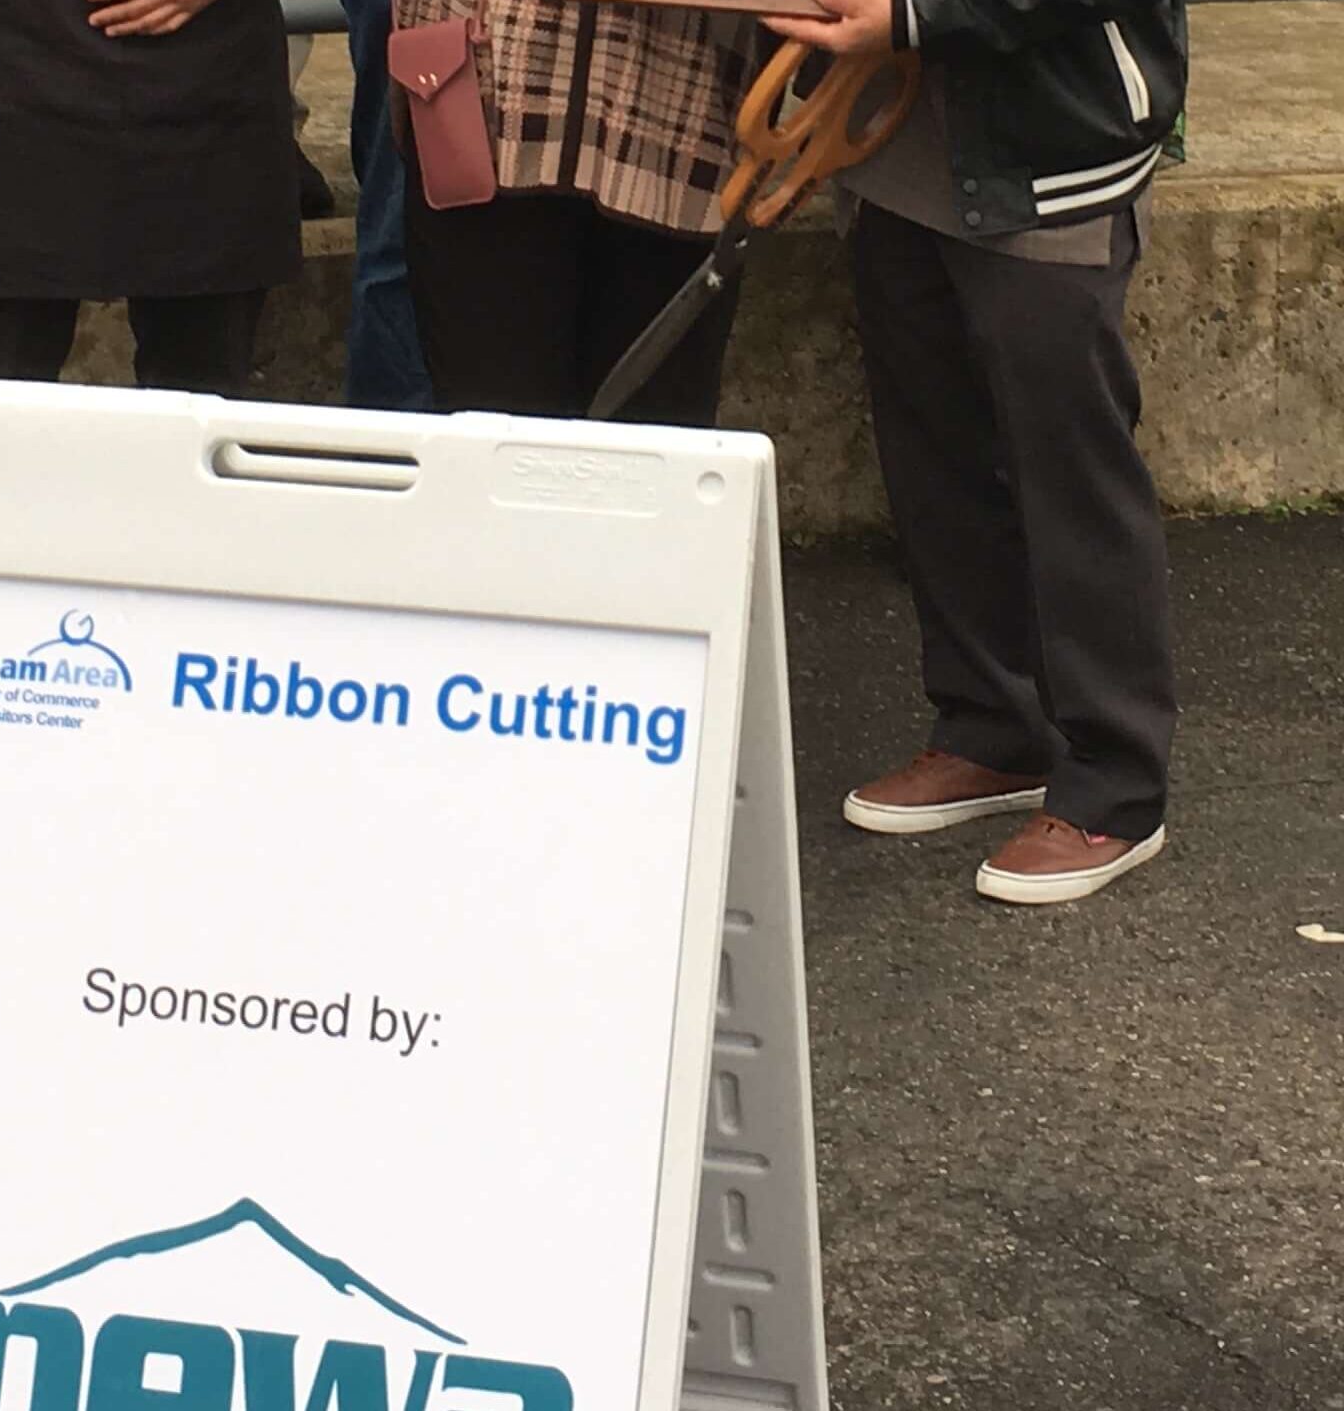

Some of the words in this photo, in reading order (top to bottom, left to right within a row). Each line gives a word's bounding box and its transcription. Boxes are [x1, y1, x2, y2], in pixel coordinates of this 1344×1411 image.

[5, 690, 21, 703] of
[22, 689, 101, 709] Commerce
[36, 712, 84, 730] Center
[51, 658, 119, 688] Area
[171, 652, 411, 727] Ribbon
[435, 673, 687, 766] Cutting
[82, 967, 351, 1039] Sponsored
[368, 994, 442, 1058] by:
